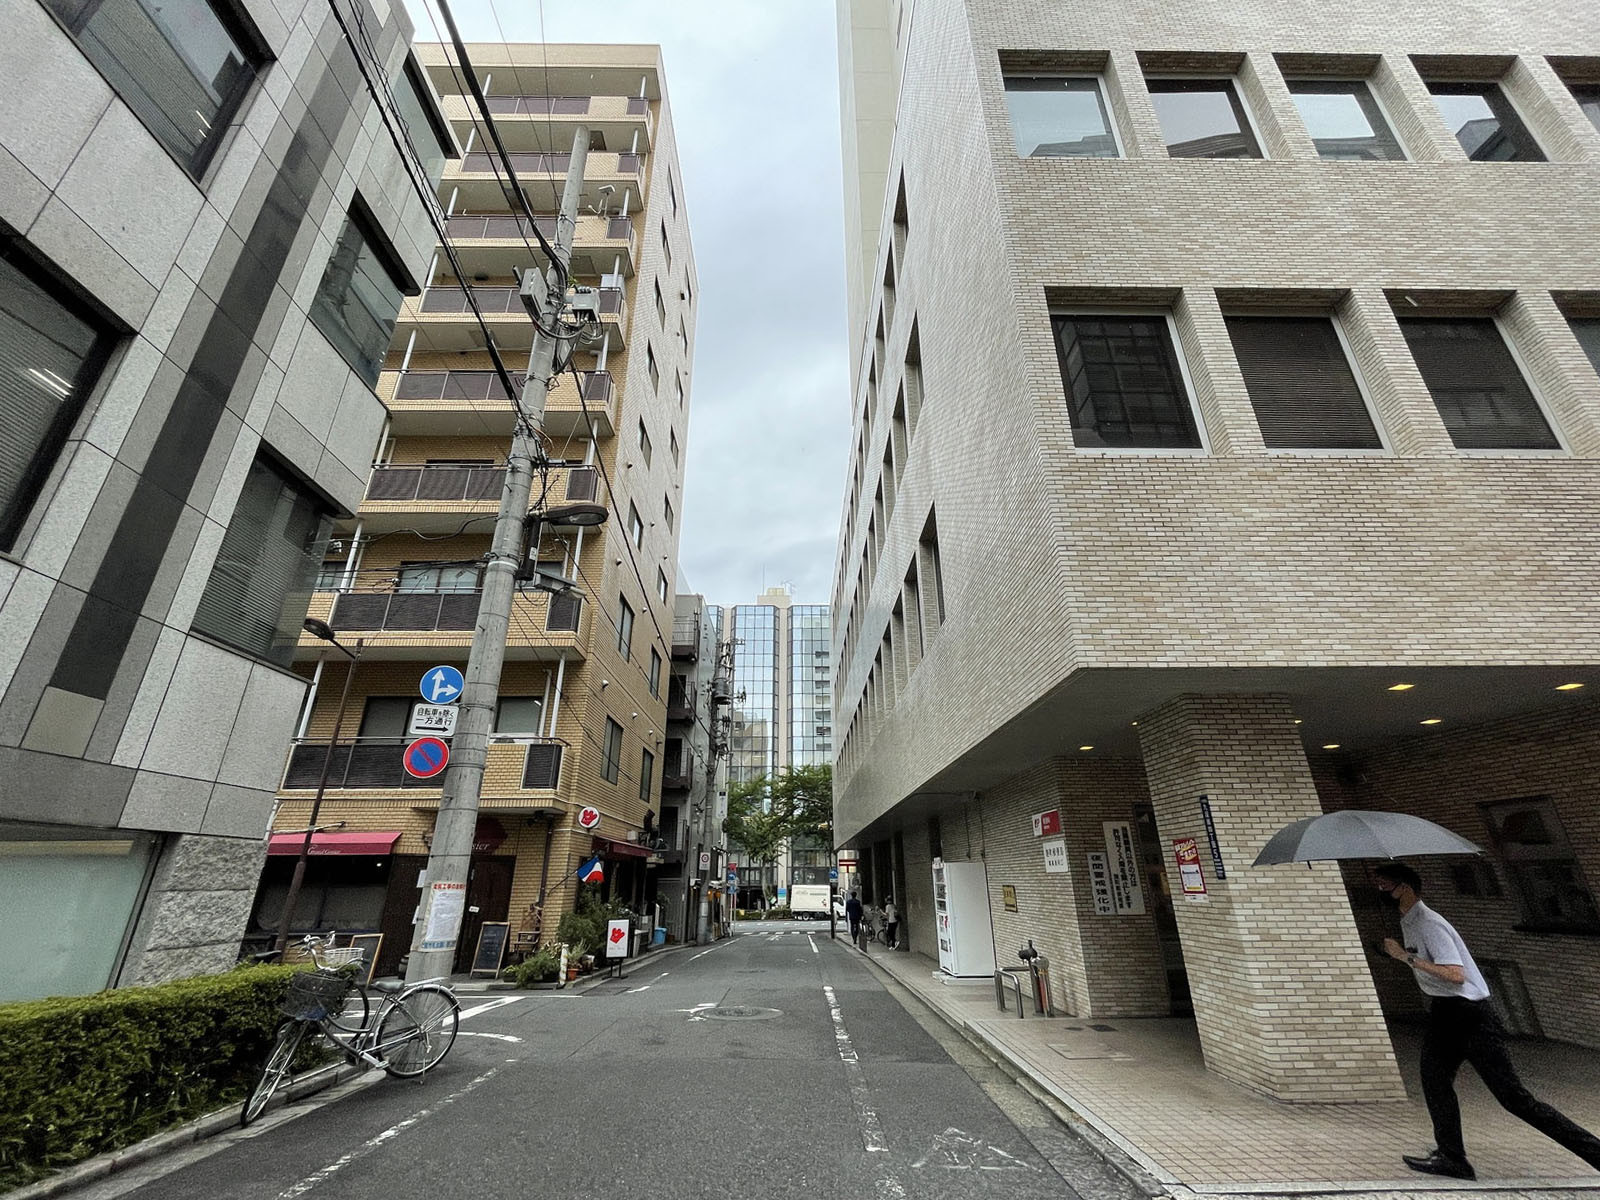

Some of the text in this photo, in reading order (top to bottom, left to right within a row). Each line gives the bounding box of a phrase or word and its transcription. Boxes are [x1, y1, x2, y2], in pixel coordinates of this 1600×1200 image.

[417, 708, 455, 718] 自転車を除く
[415, 717, 453, 726] 一方通行
